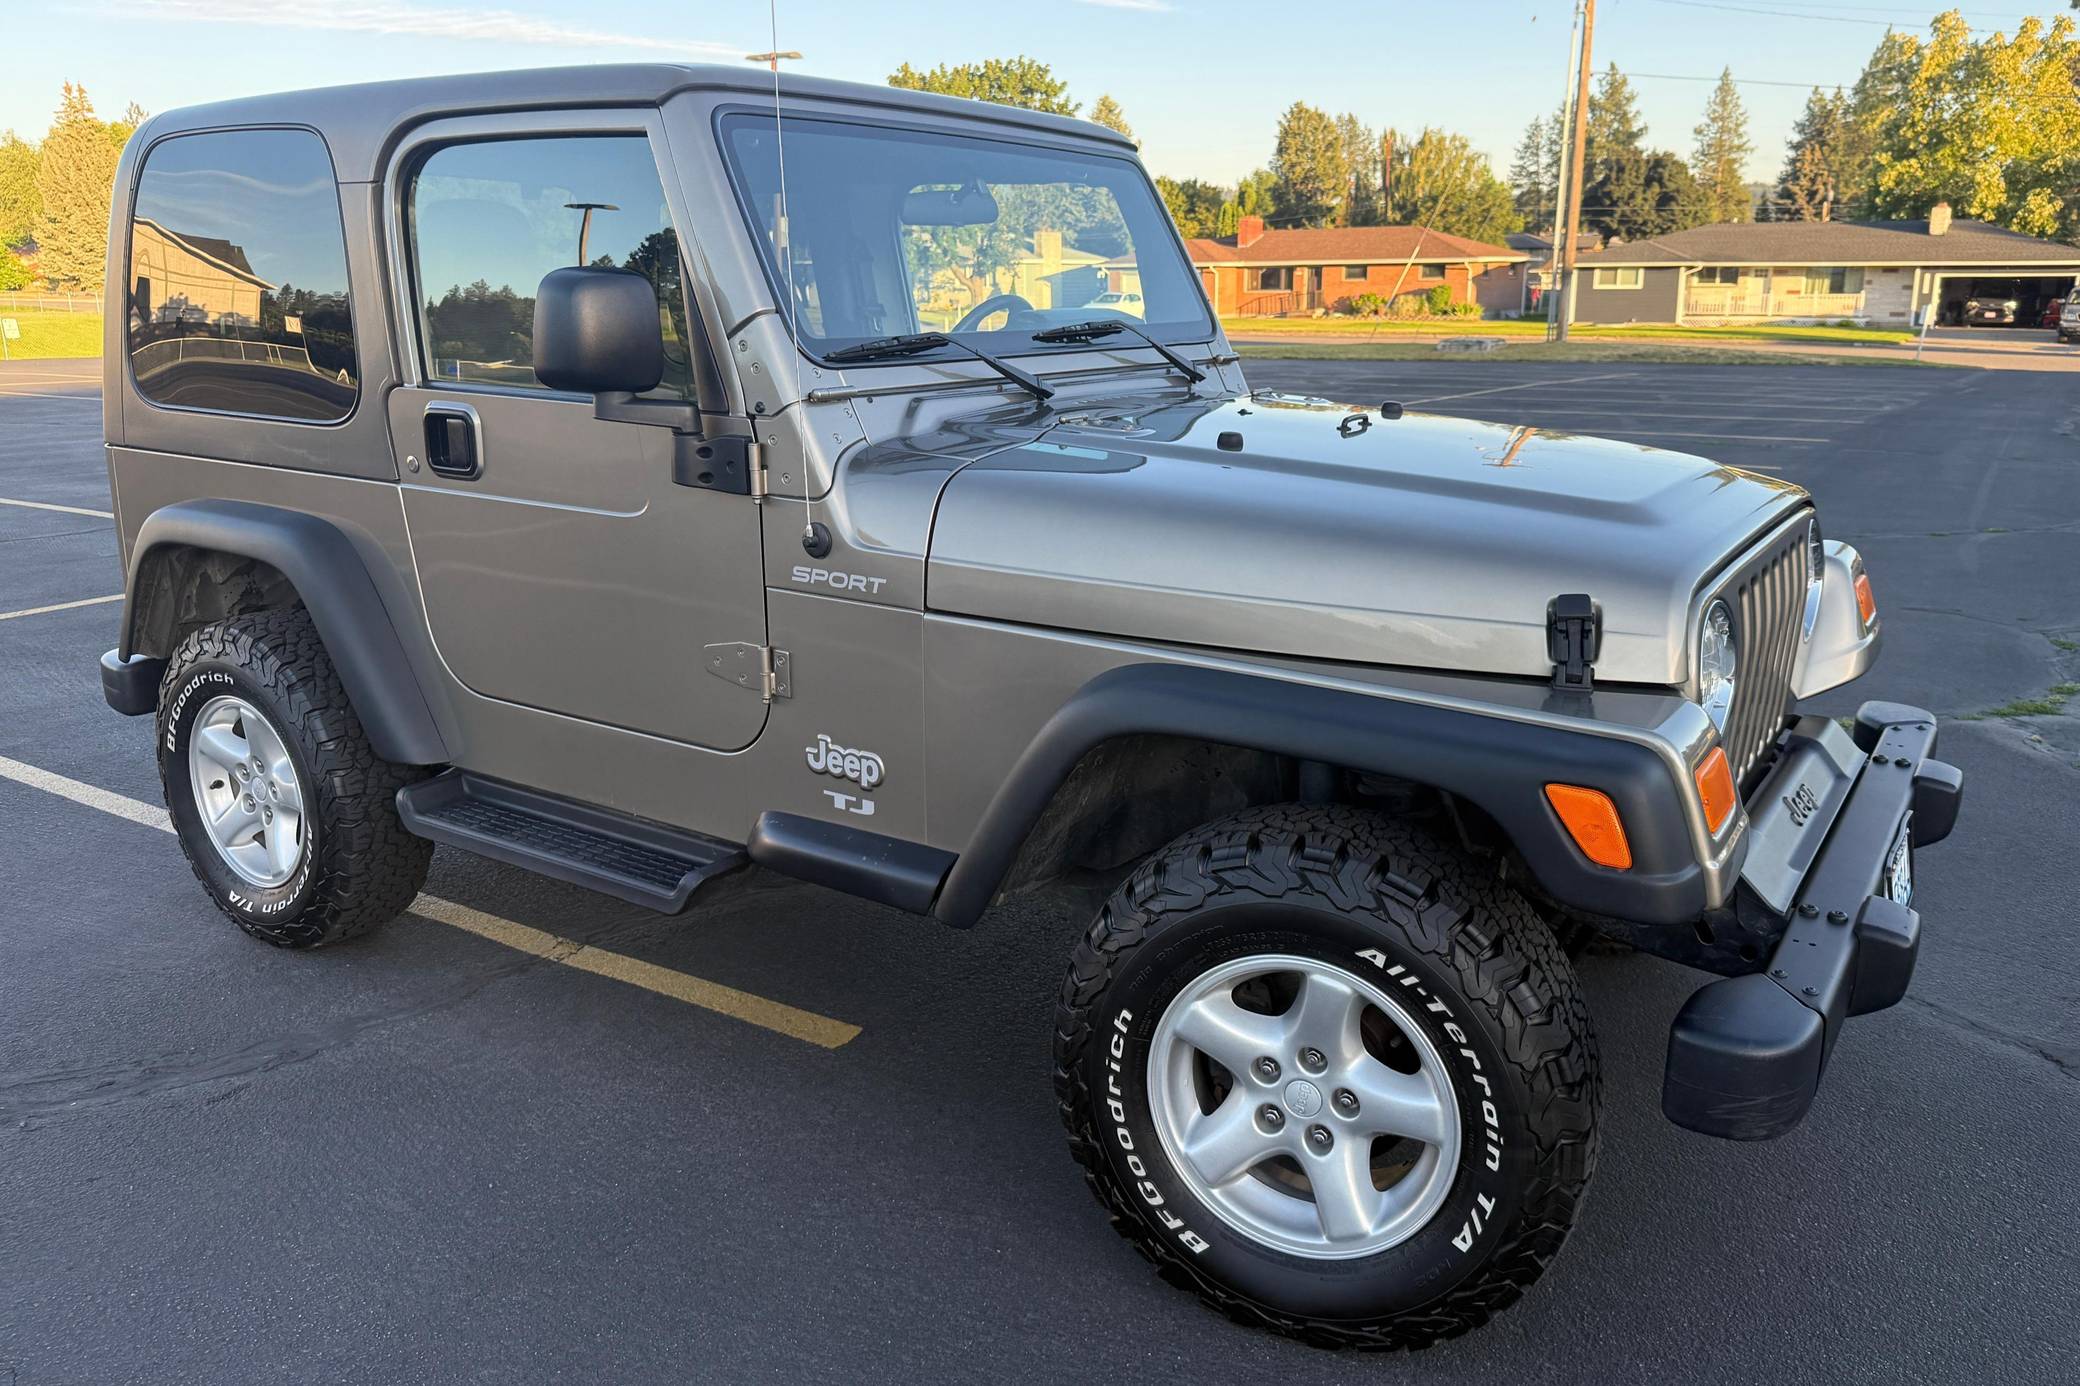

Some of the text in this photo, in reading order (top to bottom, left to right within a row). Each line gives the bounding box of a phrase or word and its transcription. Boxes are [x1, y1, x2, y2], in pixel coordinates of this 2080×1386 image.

[792, 566, 886, 593] SPORT
[167, 671, 234, 752] BFGoodrich
[806, 734, 885, 788] Jeep
[823, 790, 875, 815] TJ
[229, 820, 313, 914] All-Terrain T/A
[1107, 1009, 1210, 1254] BFGoodrich
[1354, 947, 1504, 1172] All-Terrain
[1452, 1192, 1496, 1253] T/A
